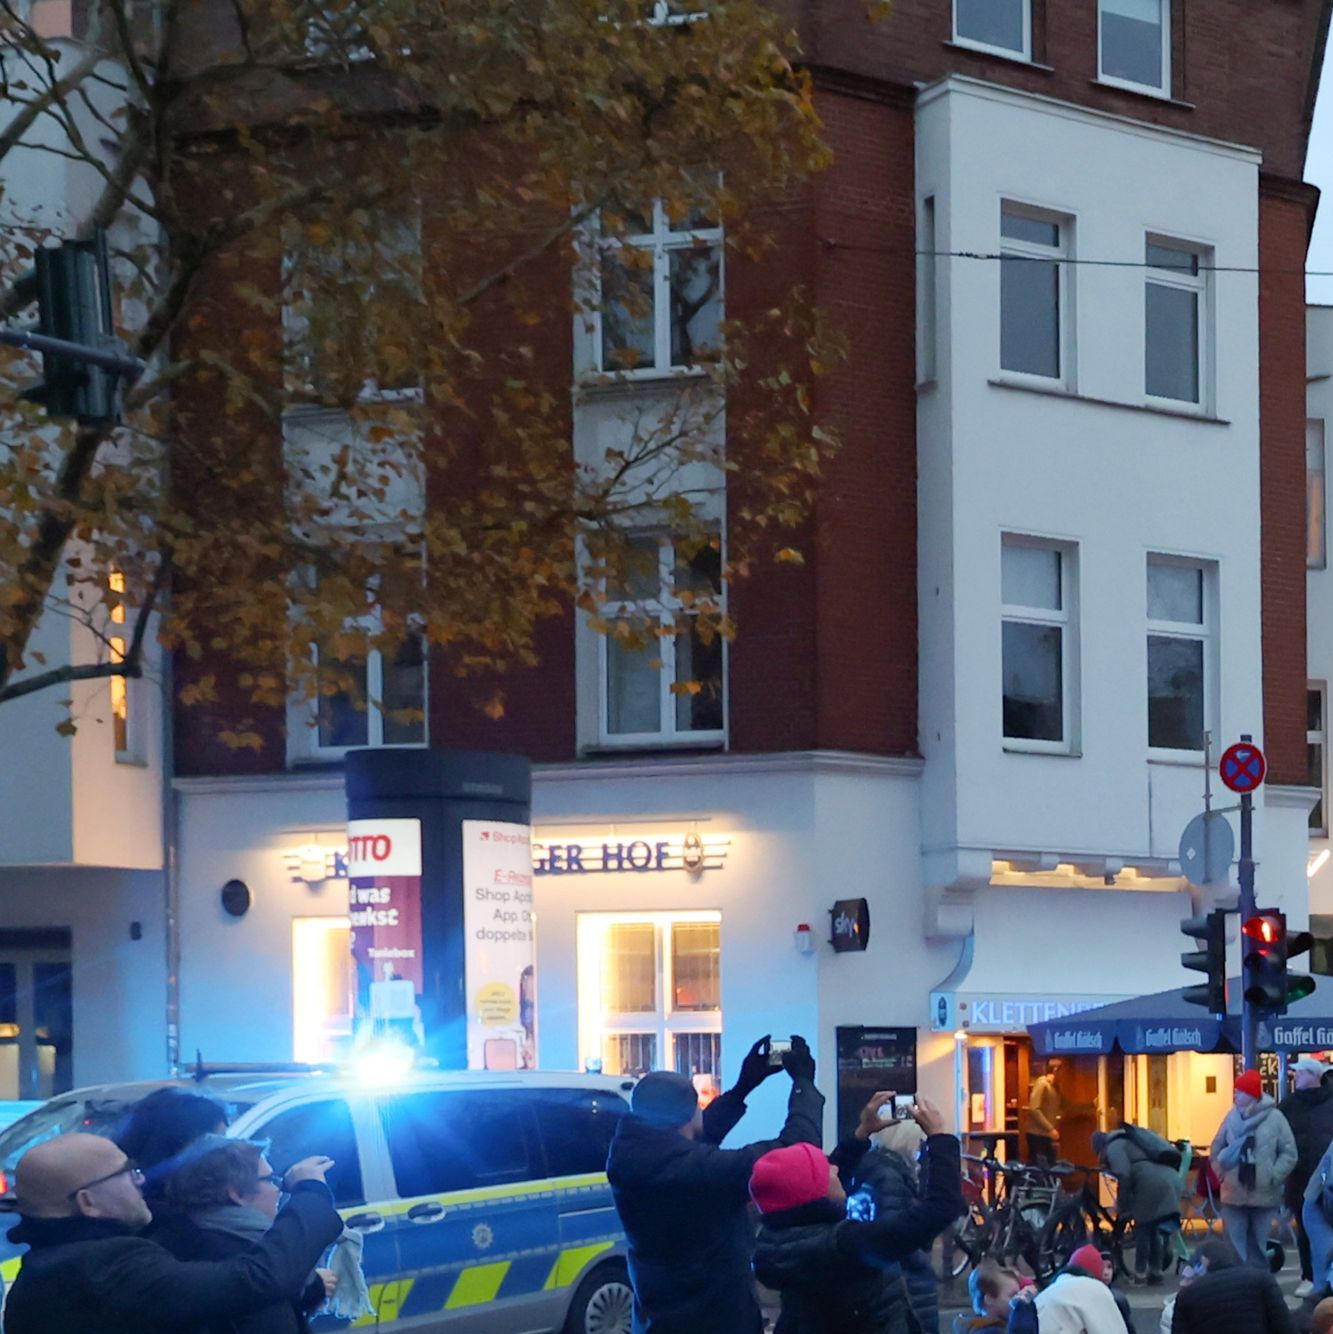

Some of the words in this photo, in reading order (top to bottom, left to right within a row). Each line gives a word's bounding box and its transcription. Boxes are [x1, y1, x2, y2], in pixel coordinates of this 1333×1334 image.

[602, 841, 670, 872] HOF
[475, 888, 511, 903] Shop
[1275, 1027, 1314, 1045] Gaffel
